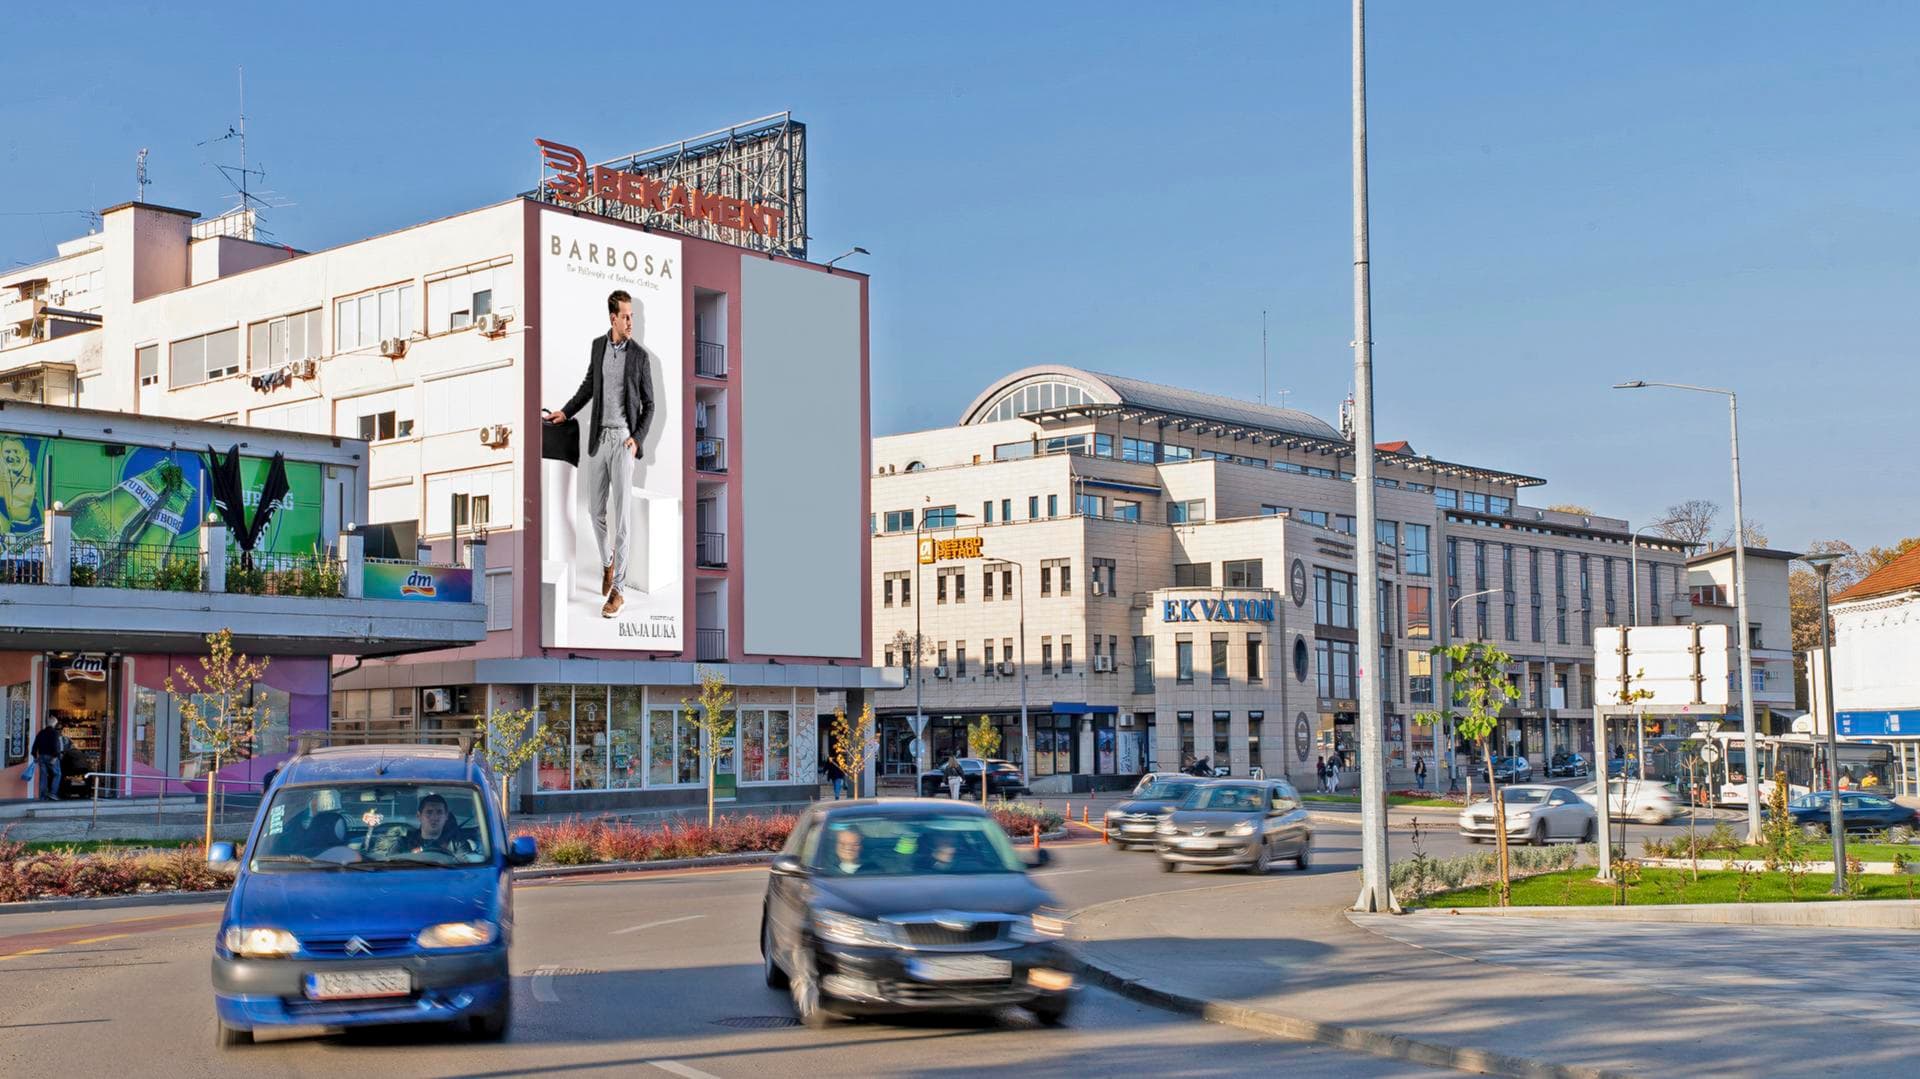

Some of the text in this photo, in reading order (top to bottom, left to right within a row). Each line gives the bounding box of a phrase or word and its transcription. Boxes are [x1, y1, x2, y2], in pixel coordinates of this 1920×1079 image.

[594, 165, 785, 238] BEKAMENT
[551, 235, 673, 280] BARBOSA
[936, 547, 983, 560] PETROL
[407, 570, 432, 587] dm
[1163, 598, 1275, 623] EKVATOR
[651, 623, 677, 638] LUKA
[72, 653, 102, 671] dm
